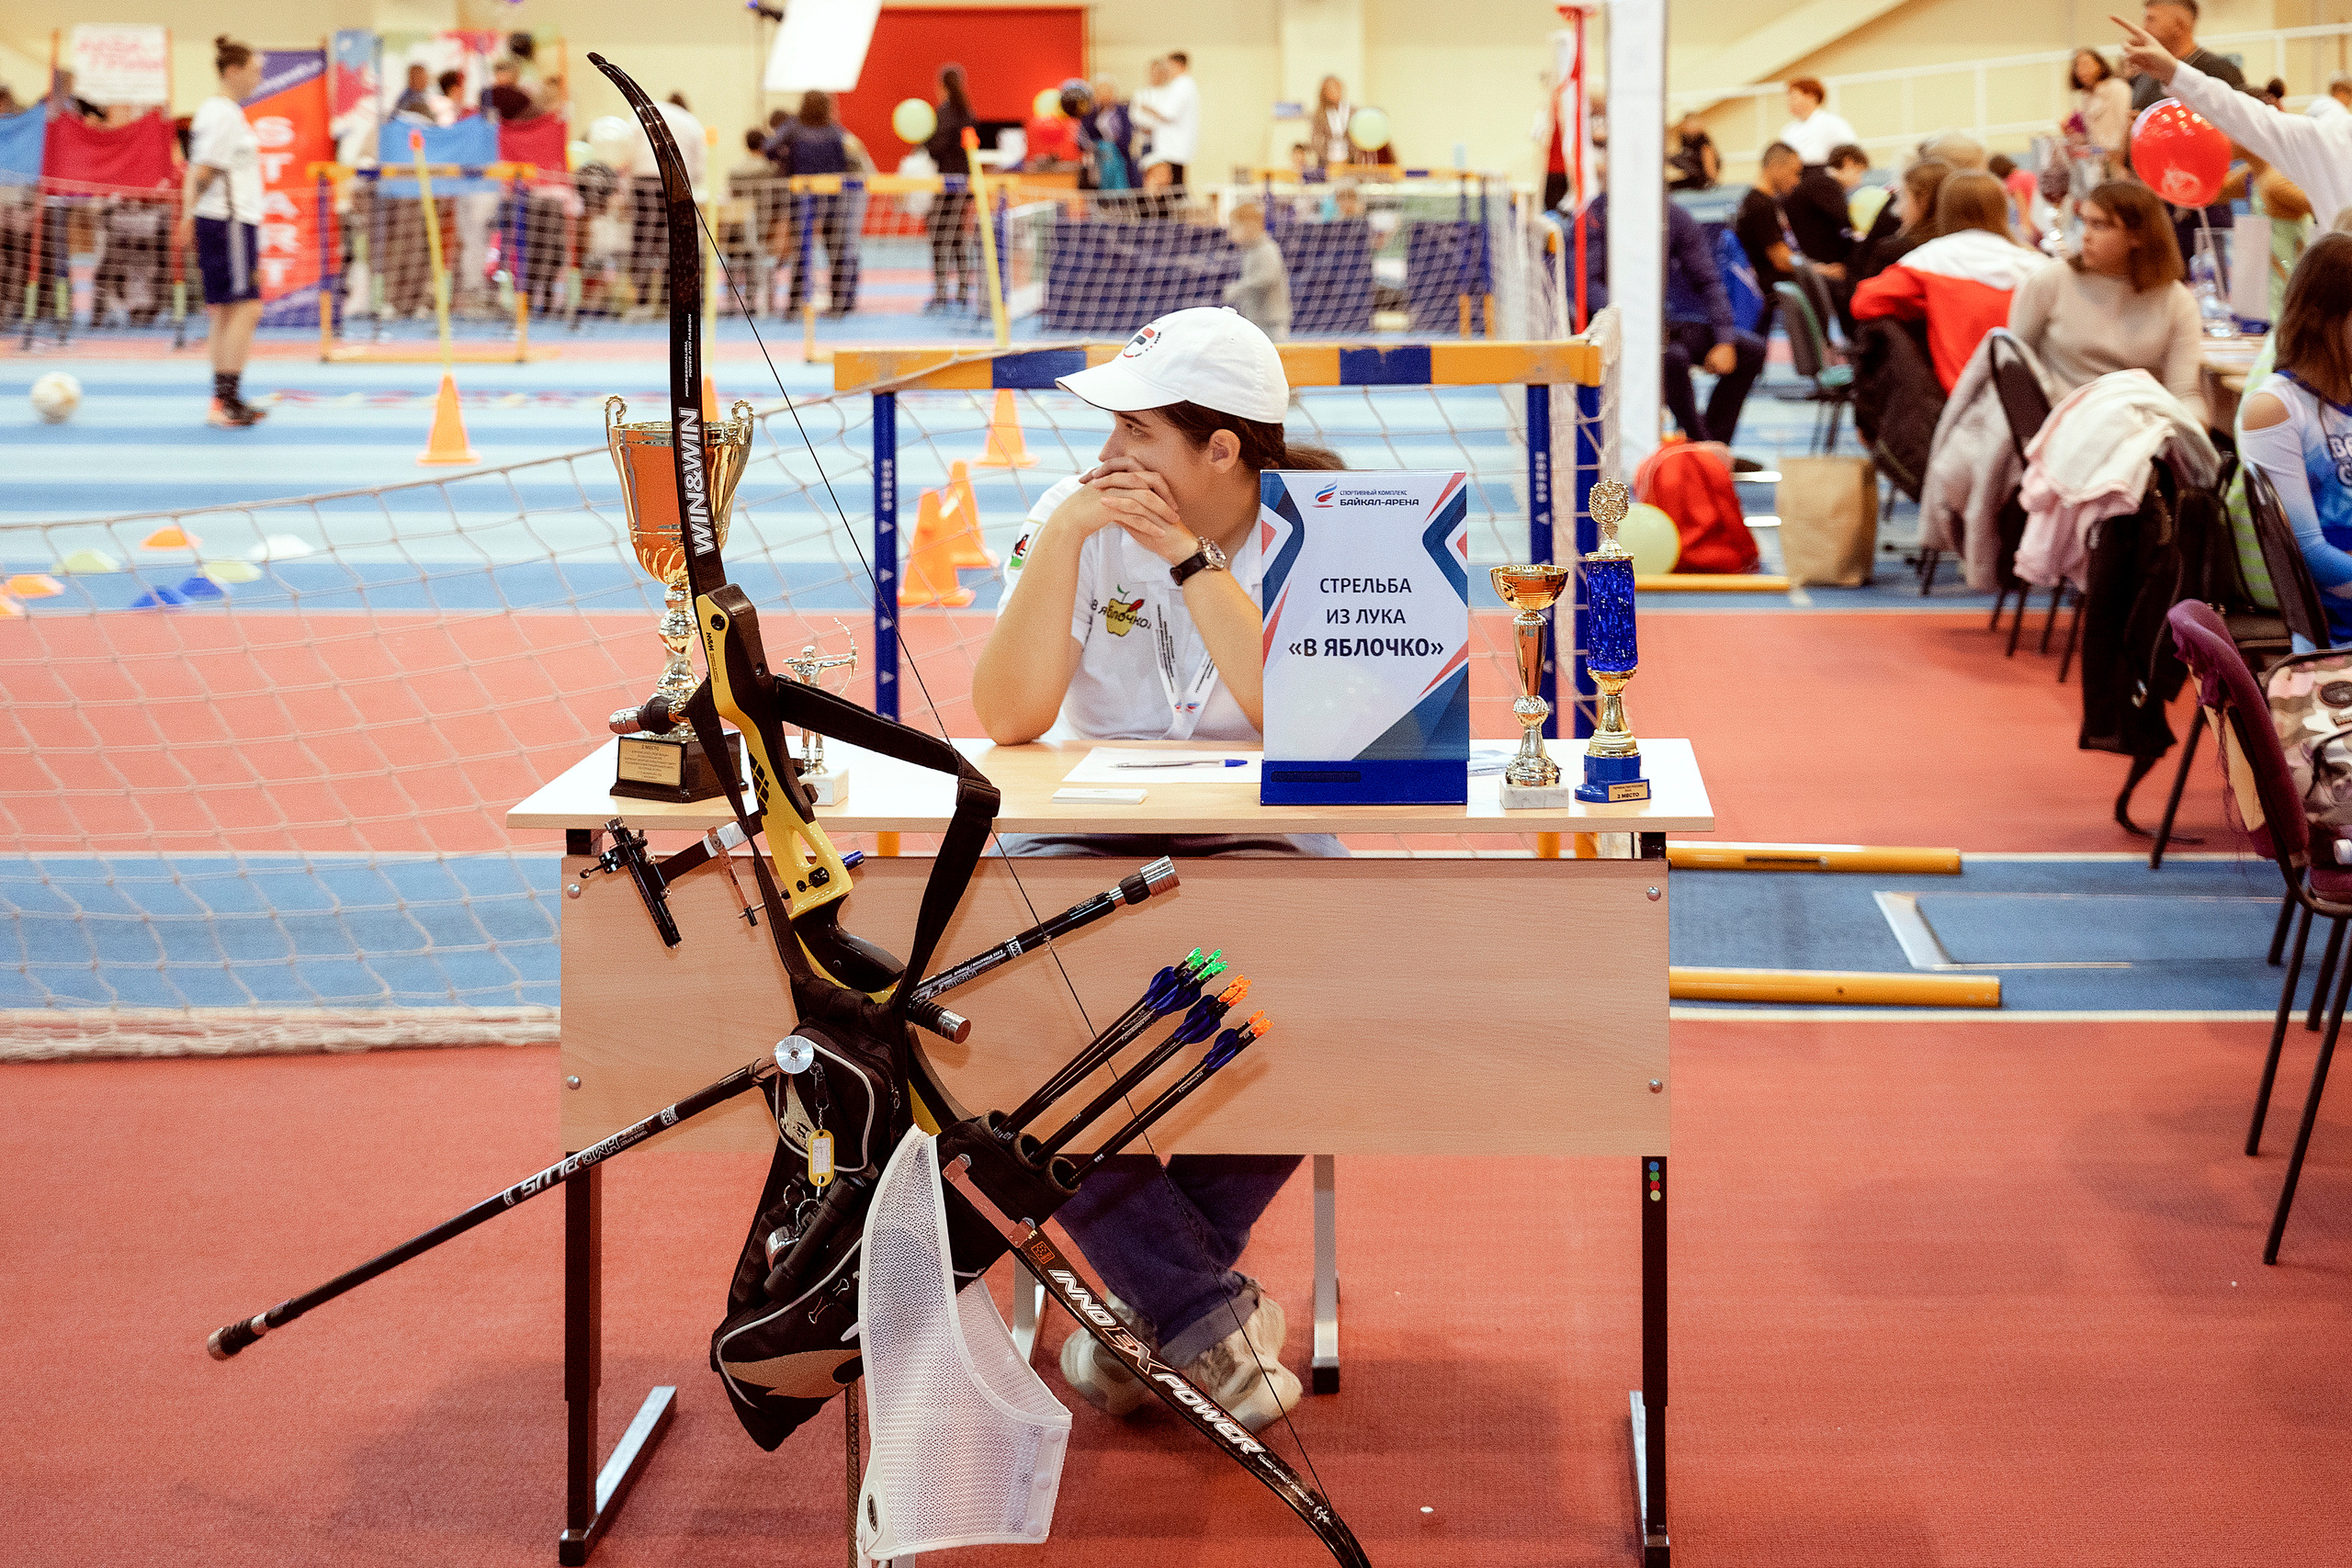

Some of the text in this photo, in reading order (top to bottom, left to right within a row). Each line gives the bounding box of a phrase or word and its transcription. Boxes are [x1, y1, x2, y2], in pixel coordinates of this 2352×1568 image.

[254, 116, 298, 288] START
[678, 407, 715, 557] WIN&WIN
[1340, 497, 1419, 506] БАЙКАЛ-АРЕНА
[1319, 578, 1412, 593] СТРЕЛЬБА
[1327, 609, 1407, 625] ИЗ ЛУКА
[1288, 638, 1444, 657] «В ЯБЛОЧКО»
[521, 1134, 621, 1198] HMC PLUS
[1047, 1269, 1117, 1326] INNO
[1102, 1326, 1176, 1375] EX
[1151, 1372, 1266, 1454] POWER
